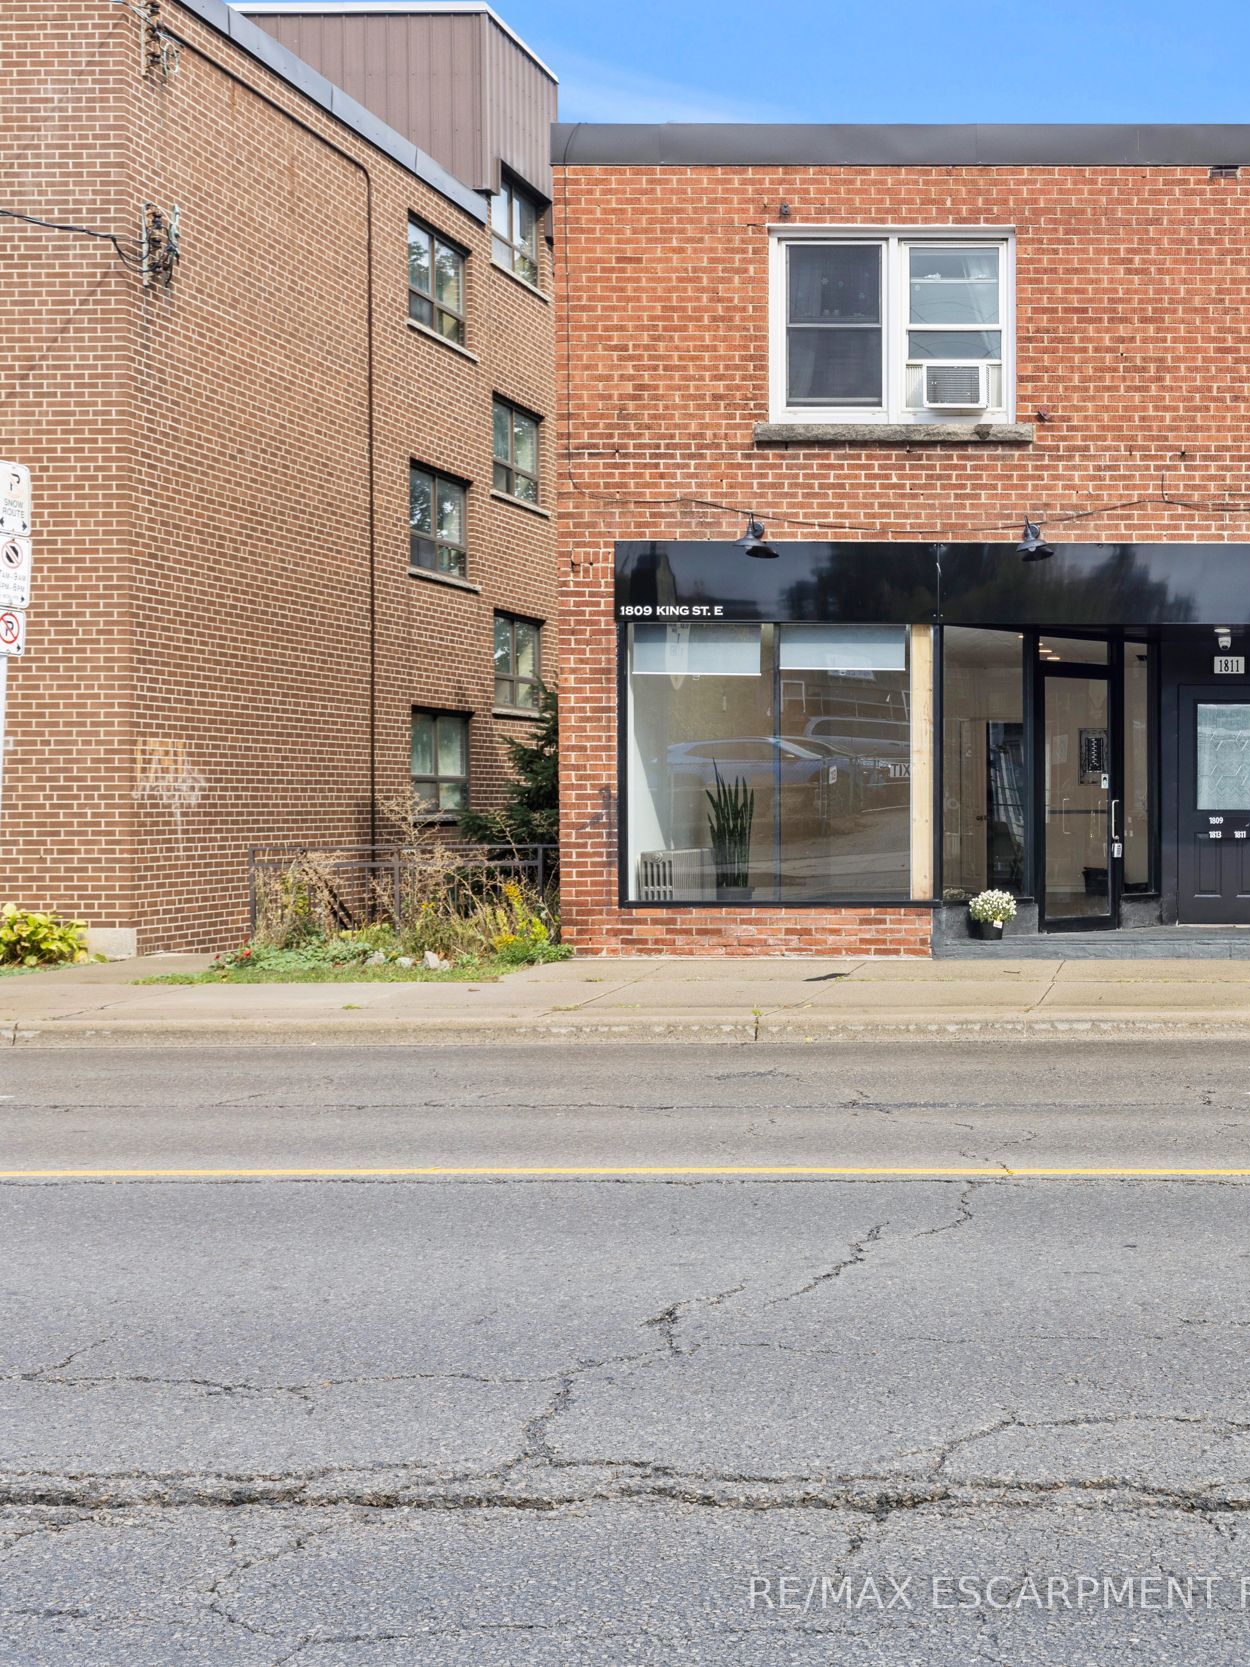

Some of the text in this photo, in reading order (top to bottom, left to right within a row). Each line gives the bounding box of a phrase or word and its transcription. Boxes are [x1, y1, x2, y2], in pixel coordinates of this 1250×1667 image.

[620, 605, 723, 616] 1809 KING ST. E
[1219, 659, 1240, 672] 1811
[1209, 816, 1224, 824] 1809
